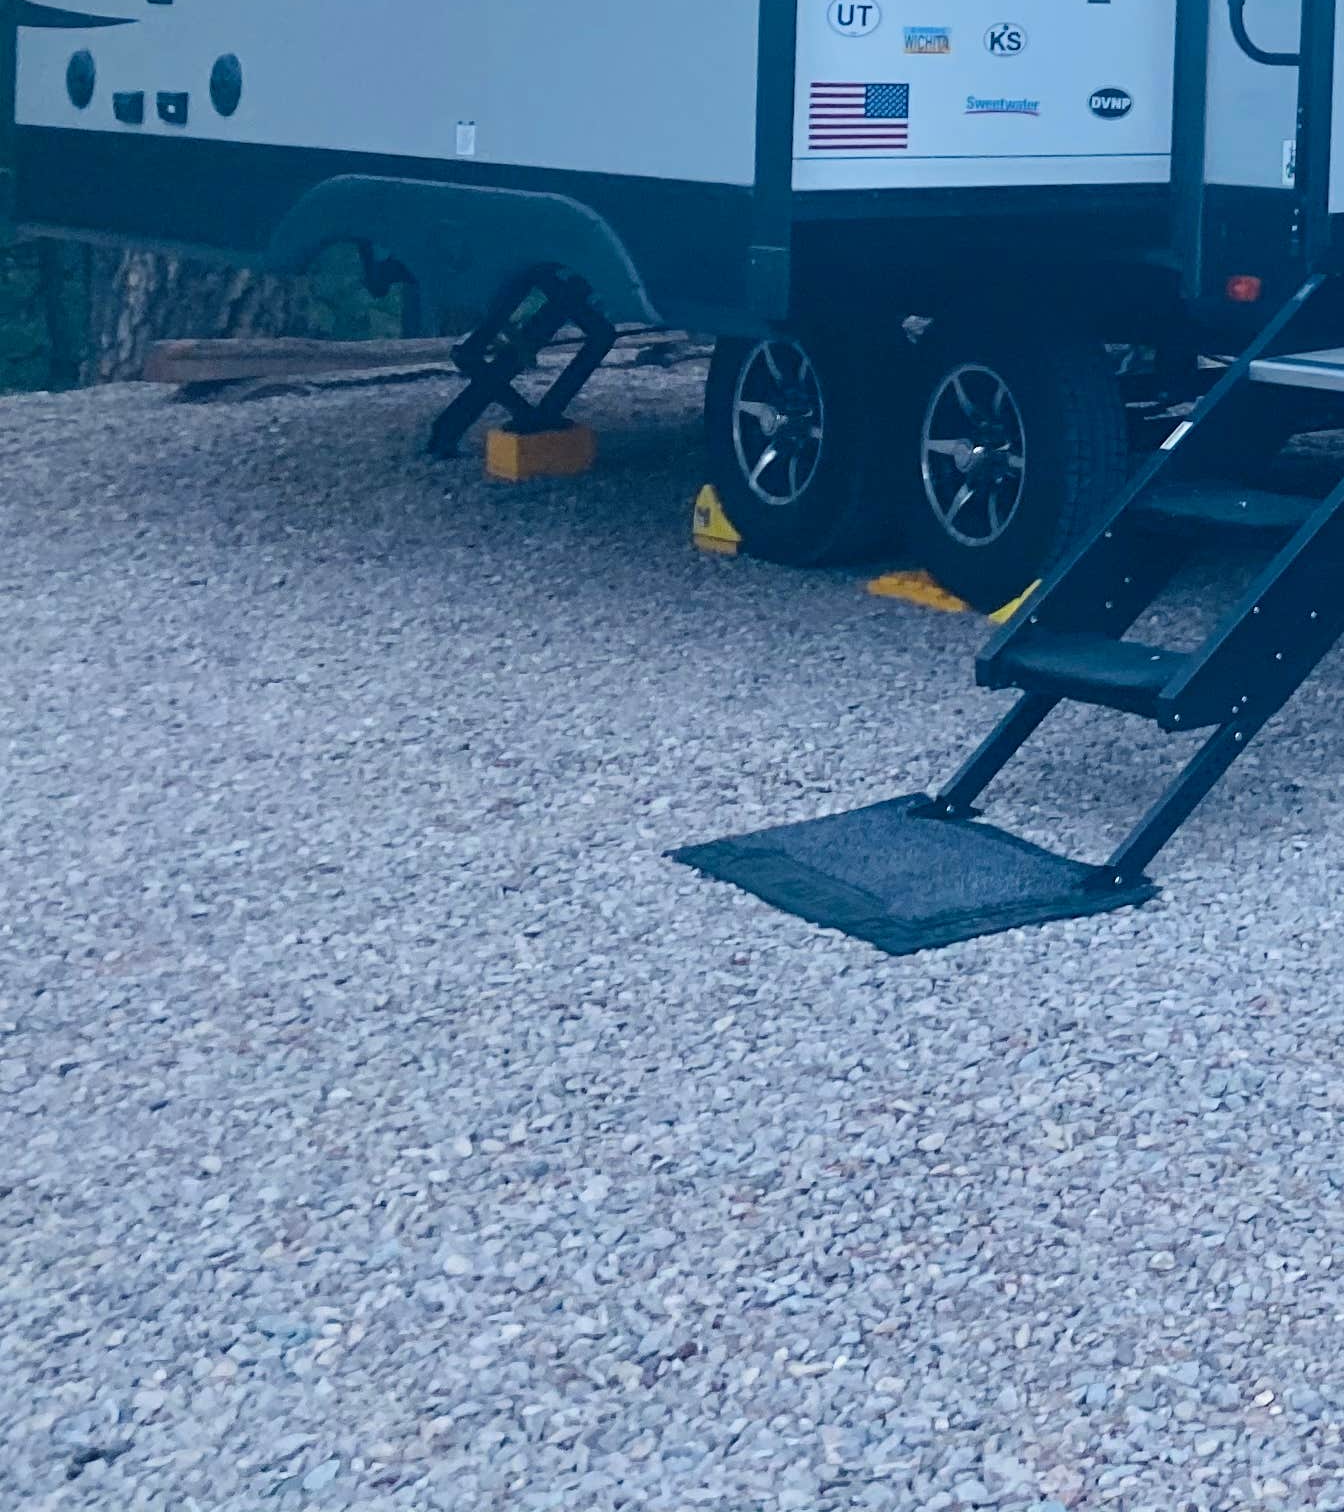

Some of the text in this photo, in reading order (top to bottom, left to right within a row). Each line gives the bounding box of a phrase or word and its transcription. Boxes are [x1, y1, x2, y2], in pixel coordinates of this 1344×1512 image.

[836, 4, 873, 27] UT
[989, 29, 1022, 52] KS
[1090, 95, 1132, 111] DVNP
